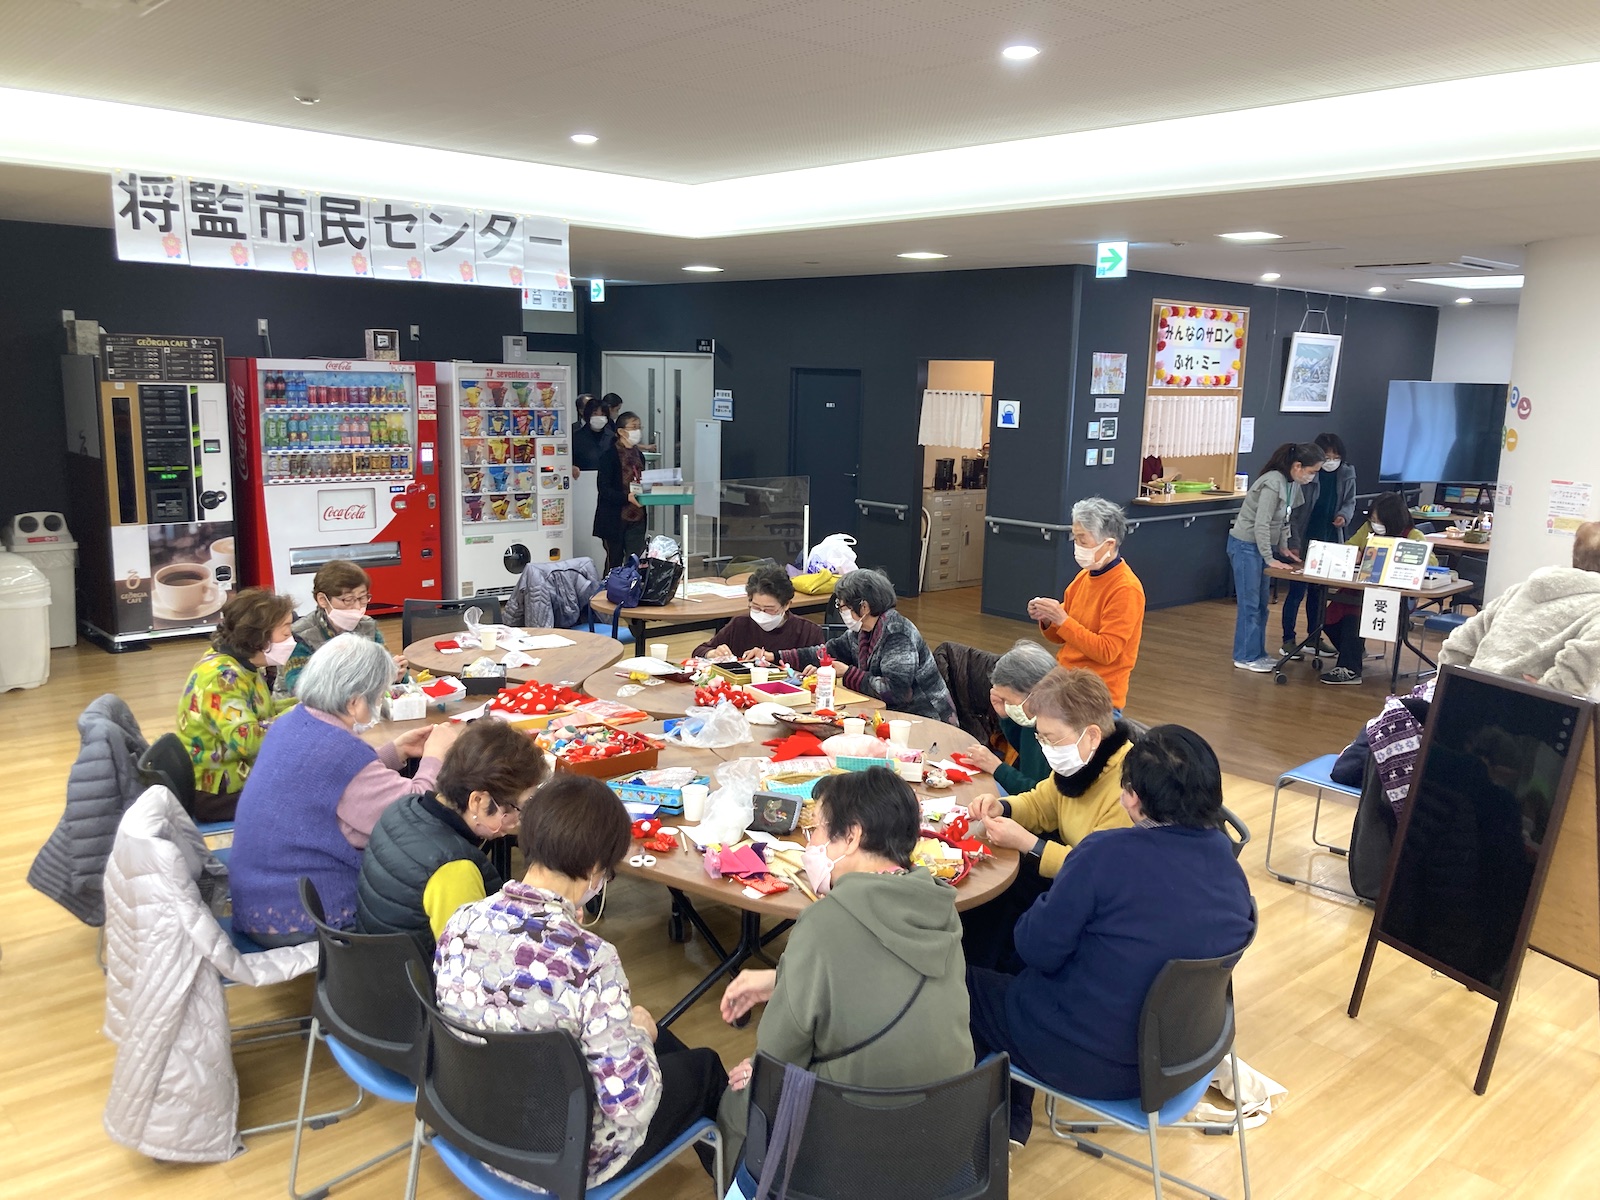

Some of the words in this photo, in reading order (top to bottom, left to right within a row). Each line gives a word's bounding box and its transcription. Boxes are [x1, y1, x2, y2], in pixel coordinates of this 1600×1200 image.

[118, 173, 562, 258] 将監市民センター
[1165, 324, 1233, 342] みんなのサロン
[325, 360, 352, 371] Coca-Cola
[1174, 354, 1220, 370] ふれ・ミー
[496, 369, 529, 378] seventeen
[530, 370, 540, 378] ice
[323, 504, 368, 521] Coca-Cola
[1372, 599, 1388, 631] 受付
